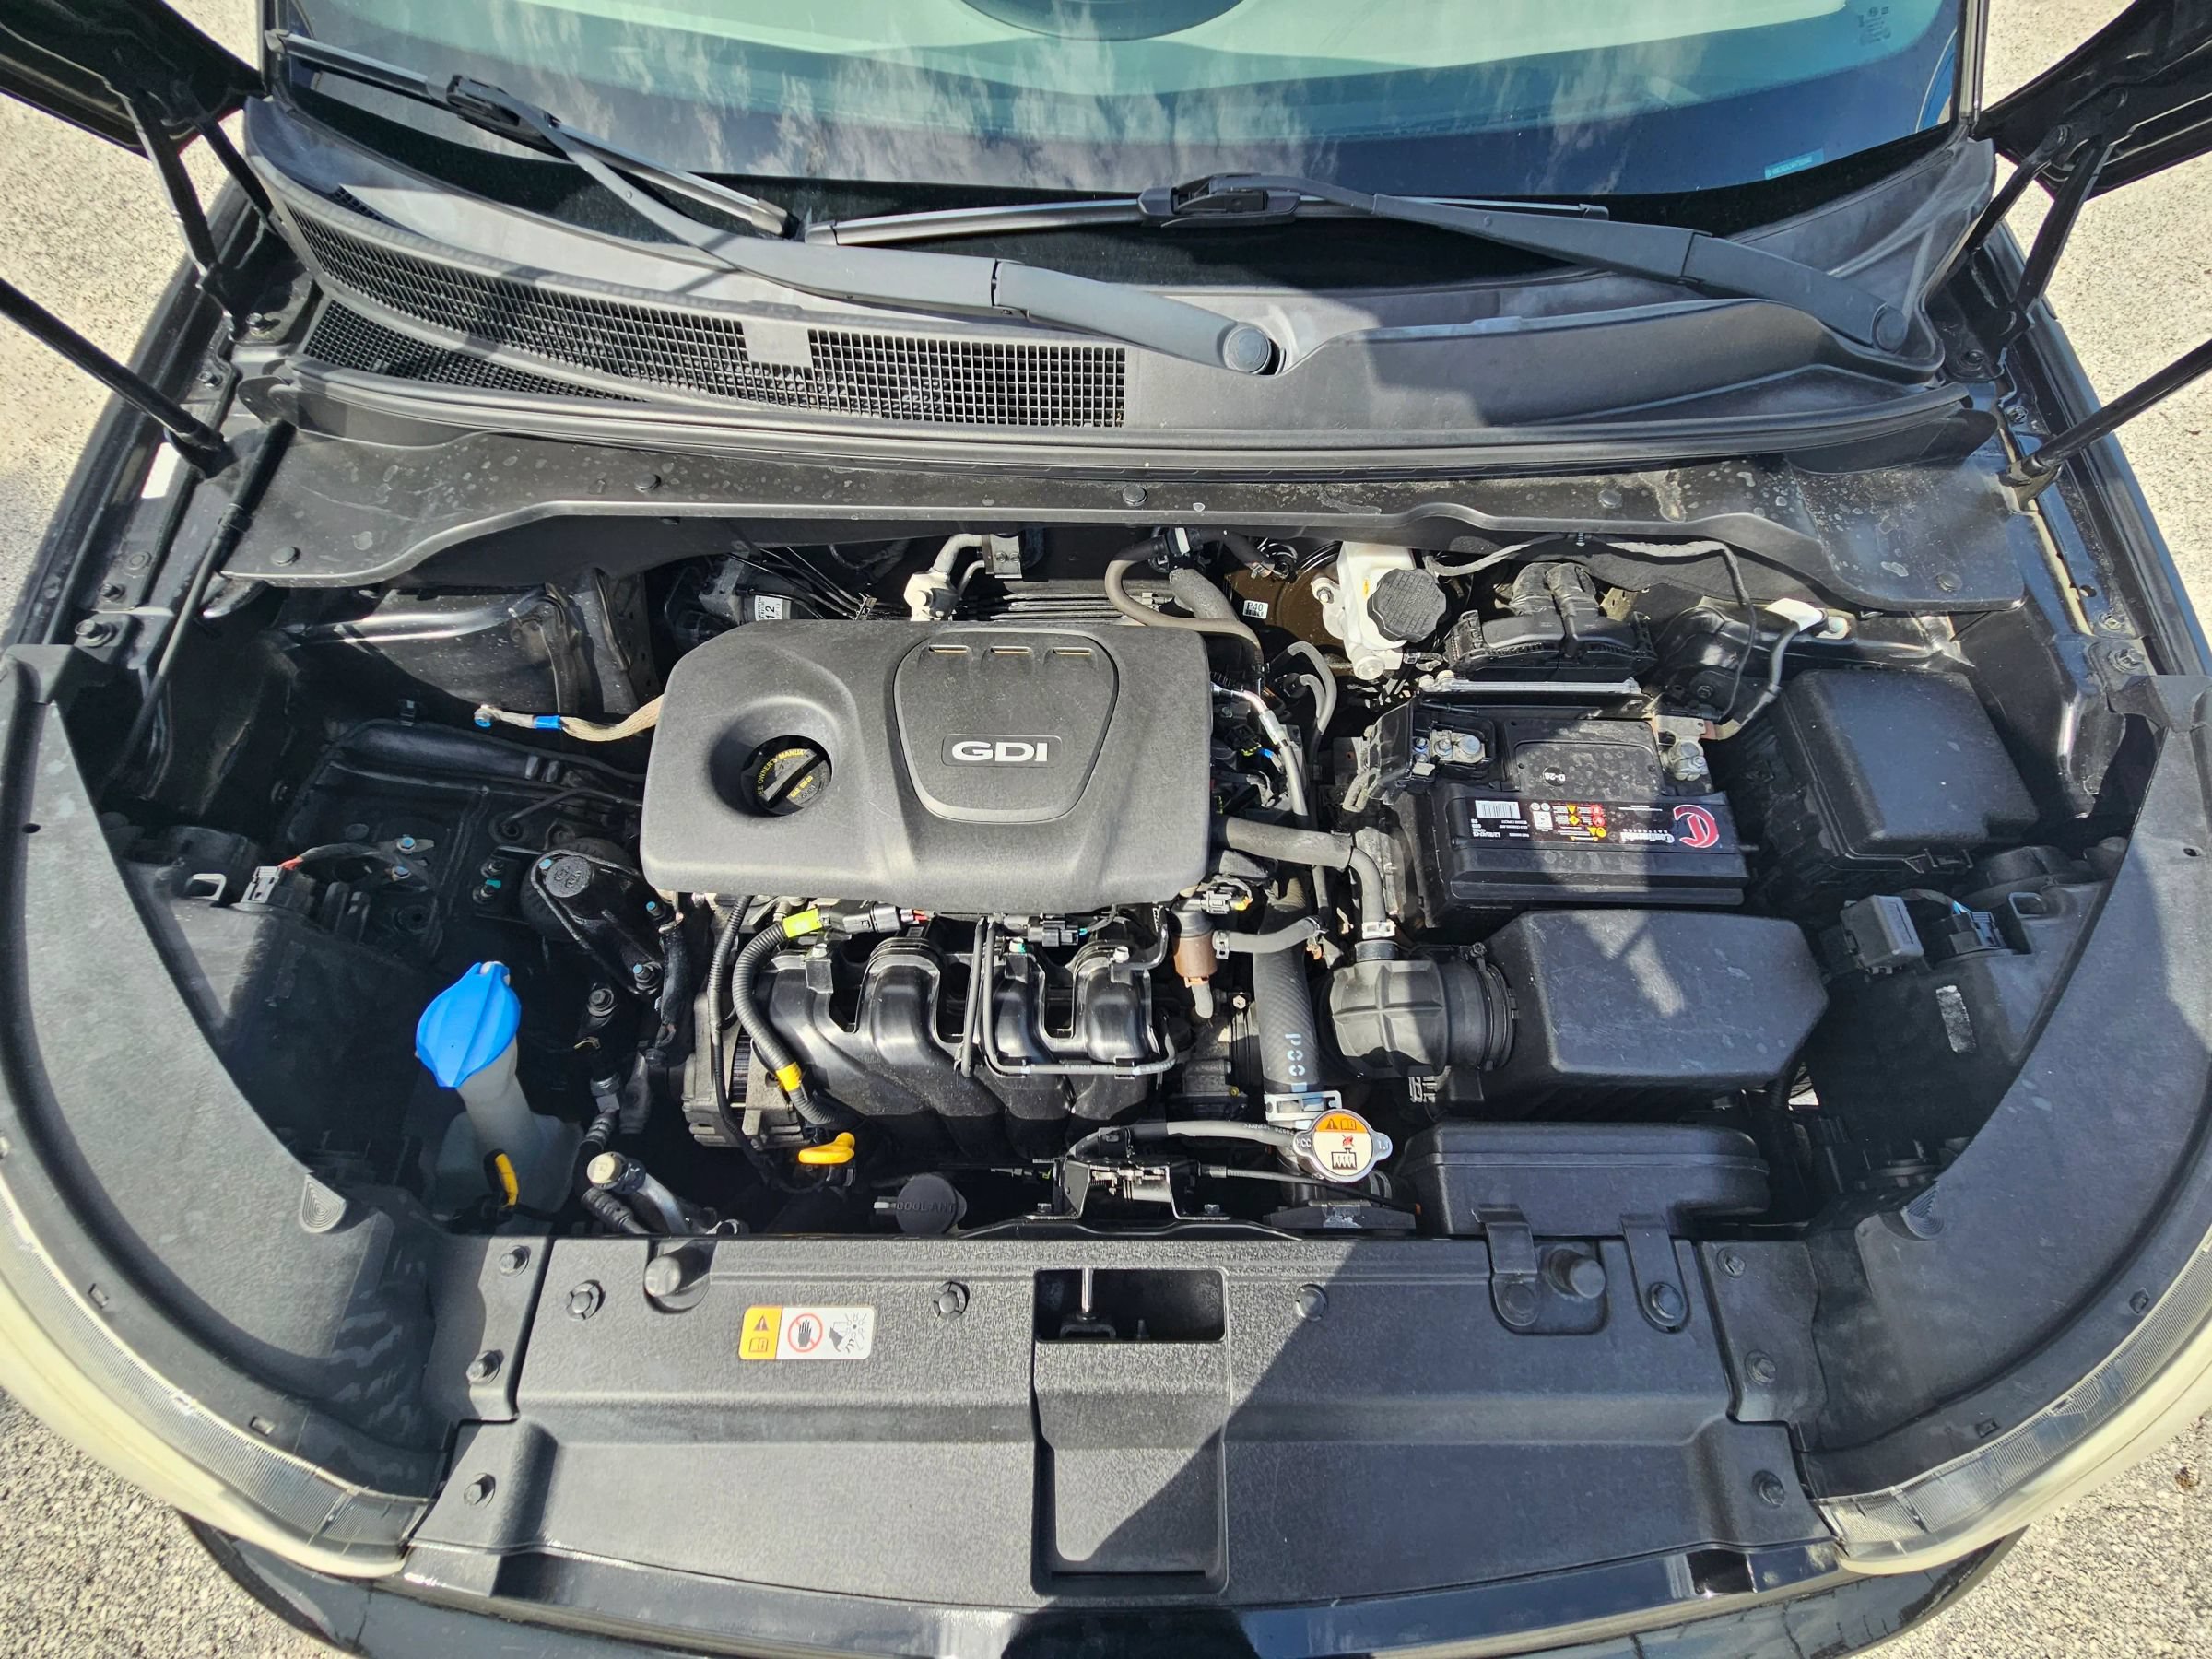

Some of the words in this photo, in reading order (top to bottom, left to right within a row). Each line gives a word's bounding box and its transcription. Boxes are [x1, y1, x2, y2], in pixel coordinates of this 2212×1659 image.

[952, 741, 1048, 762] GDI
[758, 758, 778, 784] OWNER'S
[896, 1201, 955, 1214] COOLANT
